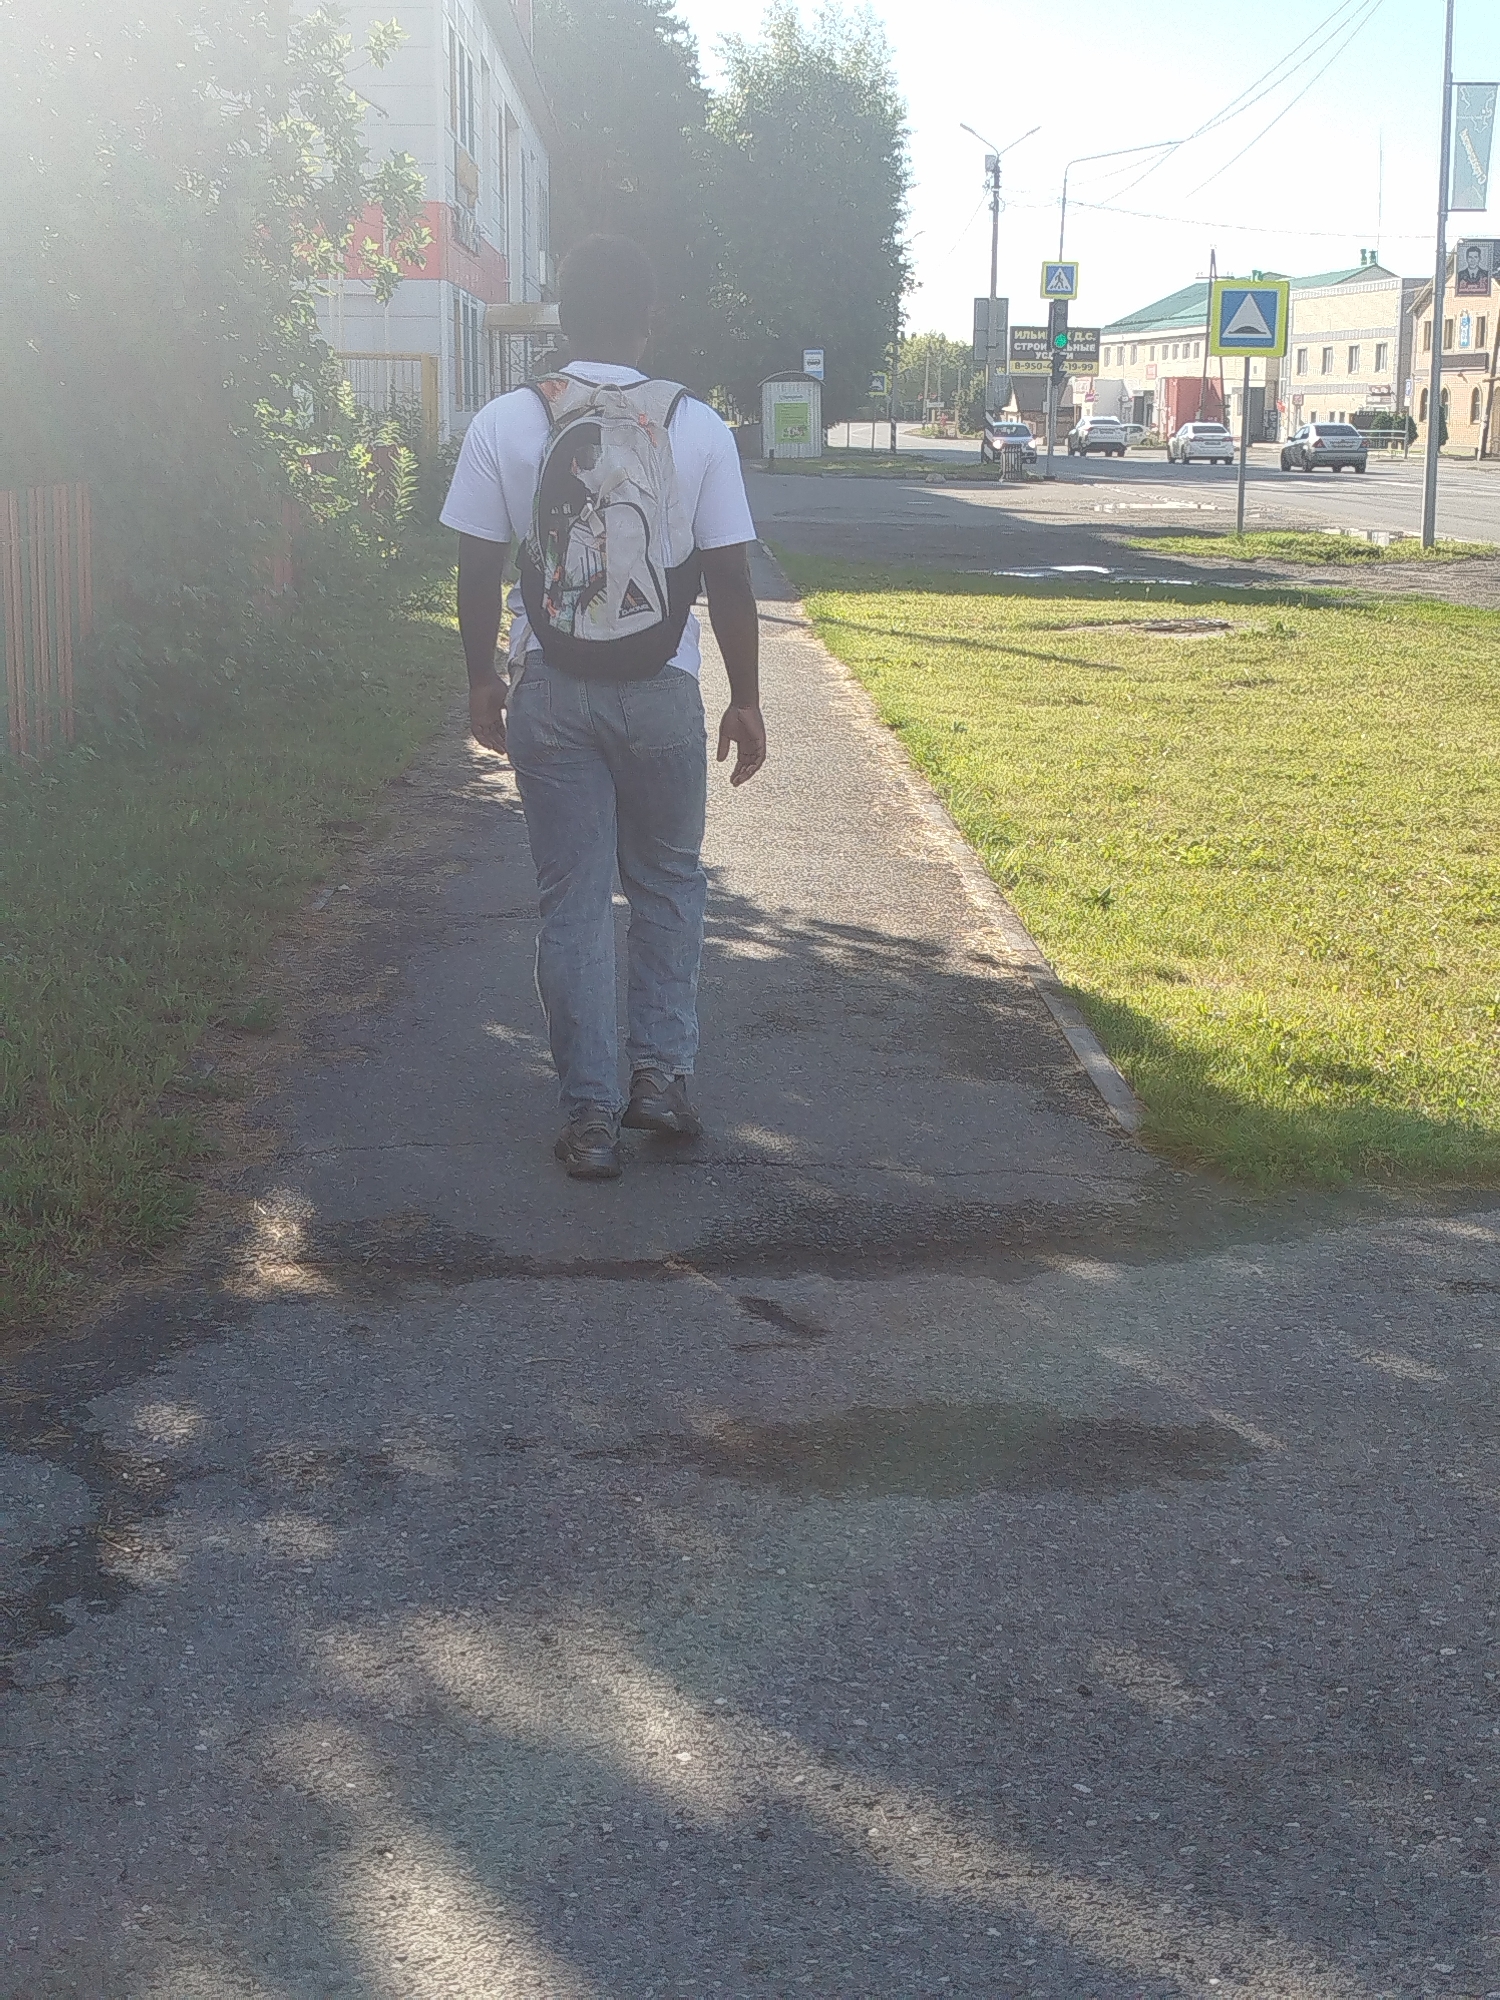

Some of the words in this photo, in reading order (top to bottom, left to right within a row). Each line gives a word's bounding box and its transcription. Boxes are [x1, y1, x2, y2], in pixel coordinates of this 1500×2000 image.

[1014, 330, 1072, 340] ИЛЬИХ
[1014, 343, 1096, 352] СТРОИЬНЫЕ
[1014, 362, 1094, 371] 8-950-47-19-99
